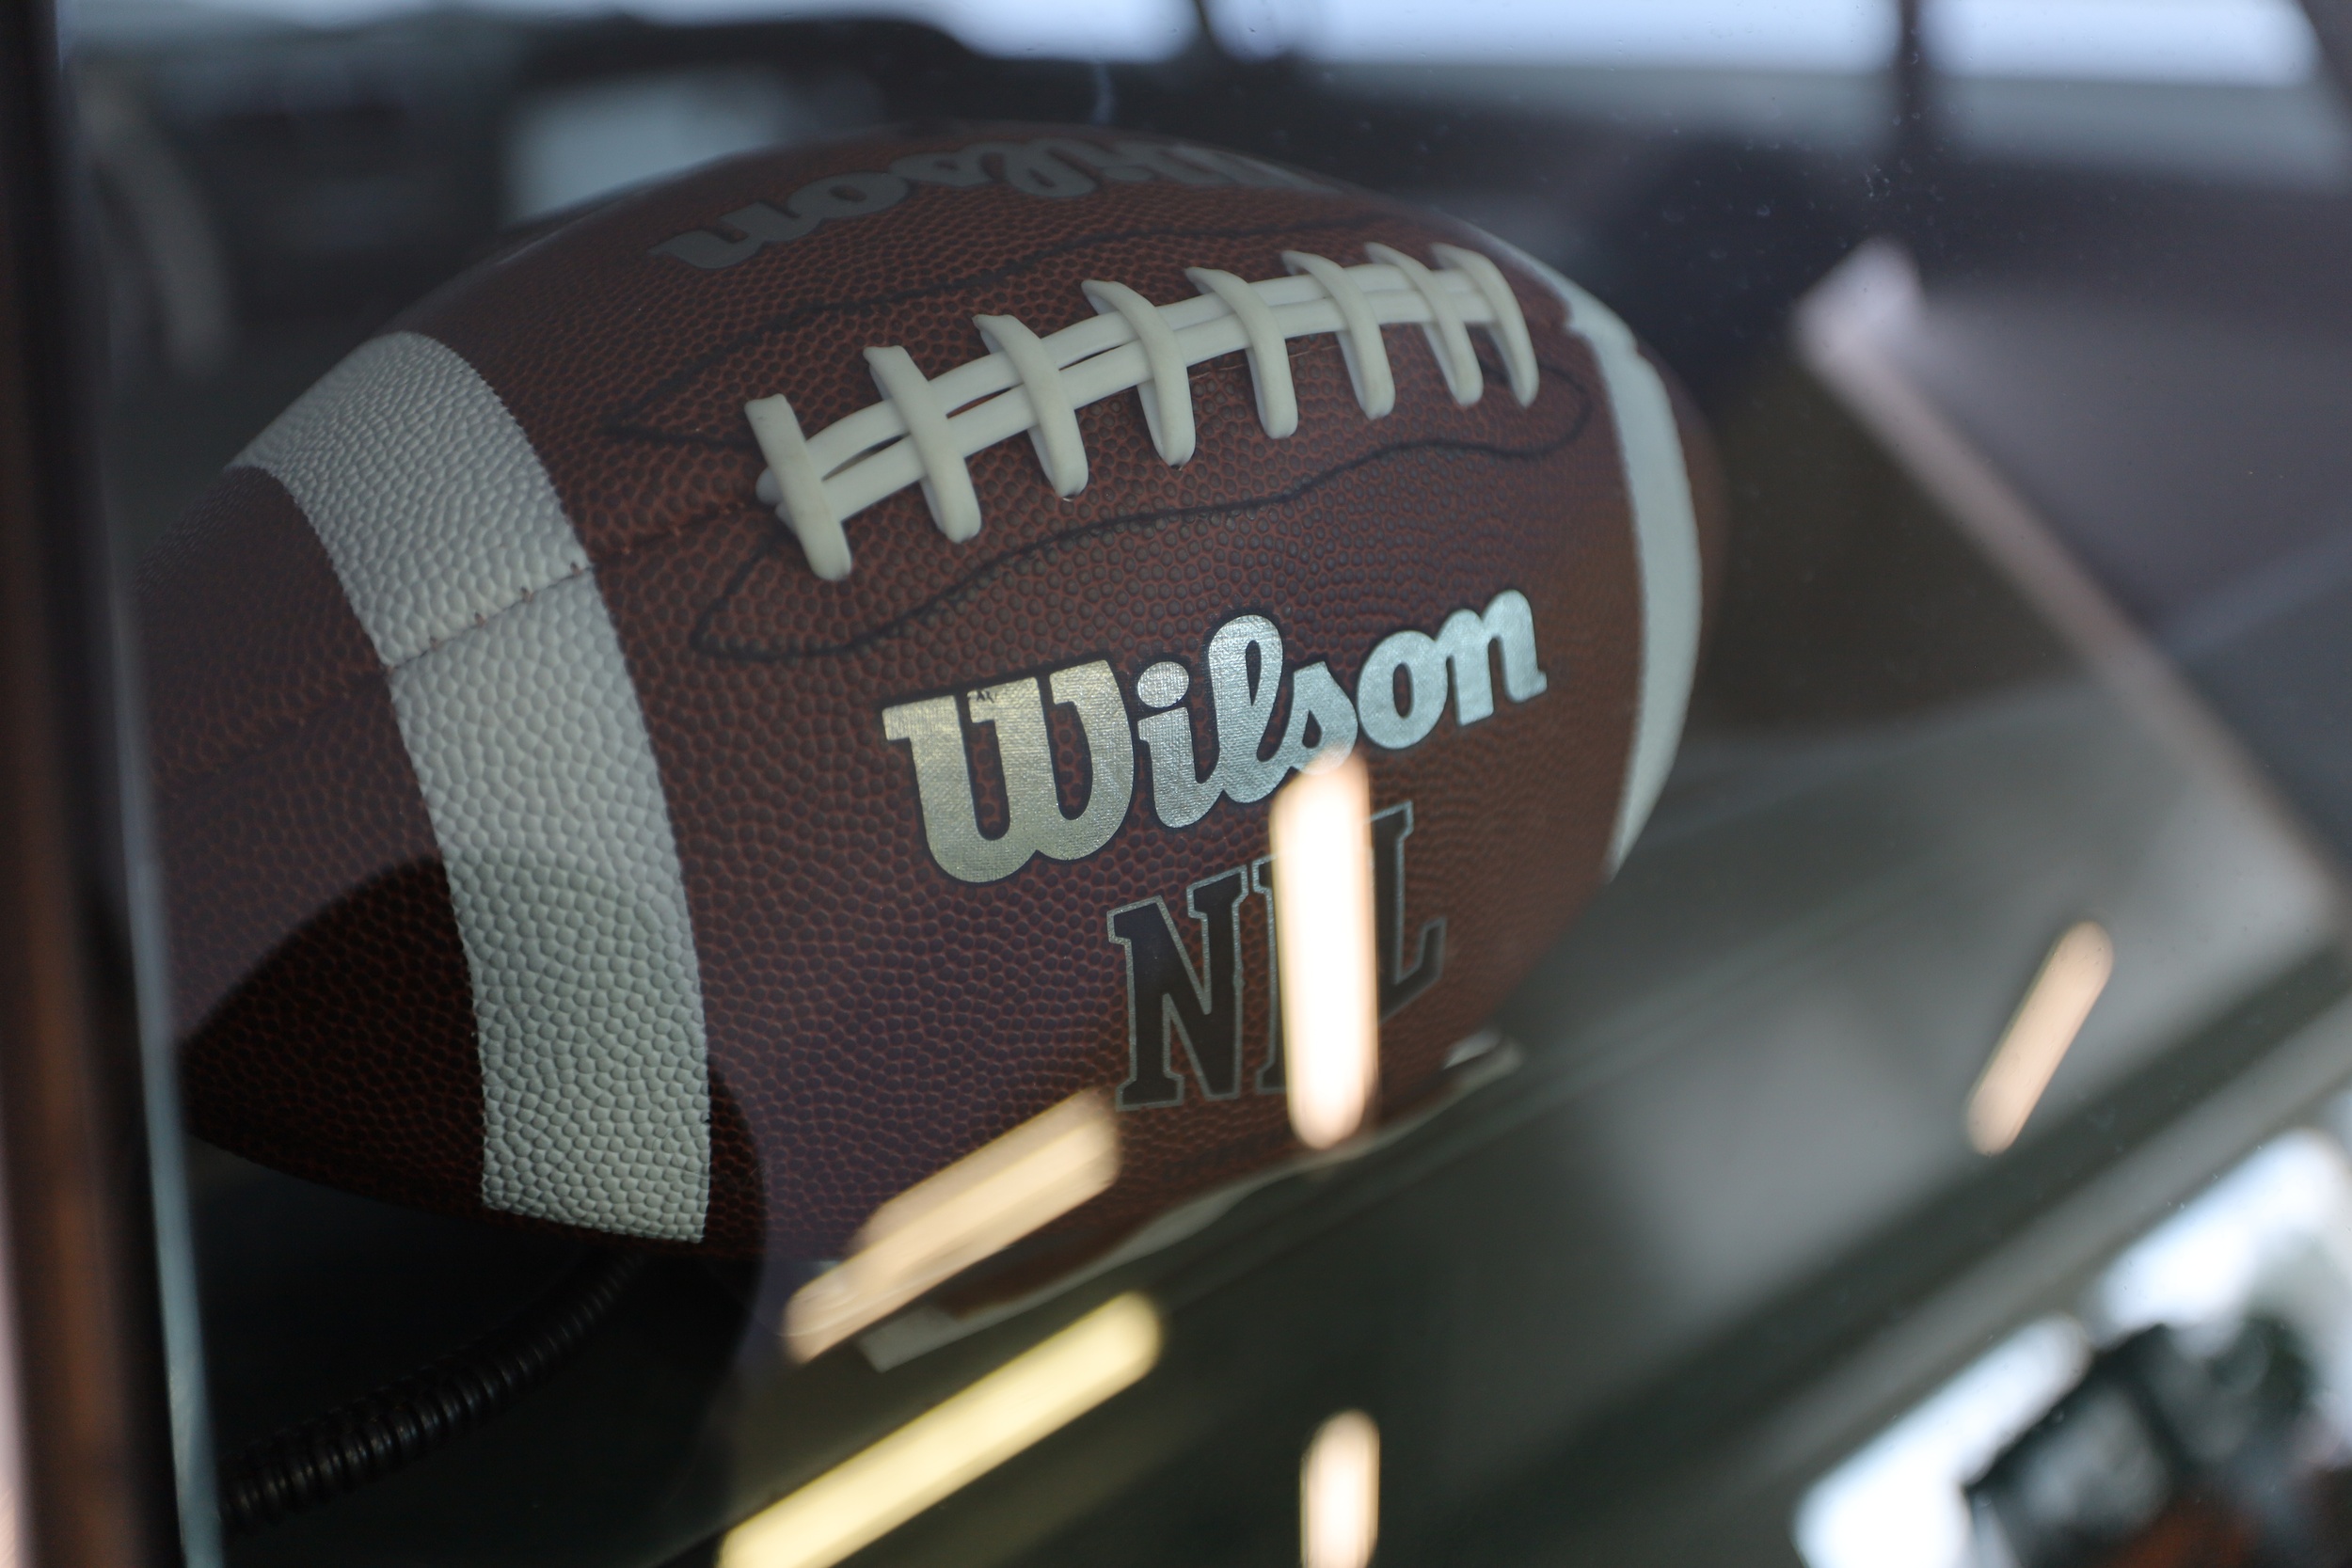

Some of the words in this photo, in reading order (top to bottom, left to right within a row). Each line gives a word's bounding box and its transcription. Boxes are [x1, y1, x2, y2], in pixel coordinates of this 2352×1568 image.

[649, 137, 1343, 269] Wilson
[882, 590, 1548, 883] Wilson
[1107, 800, 1447, 1112] NL
